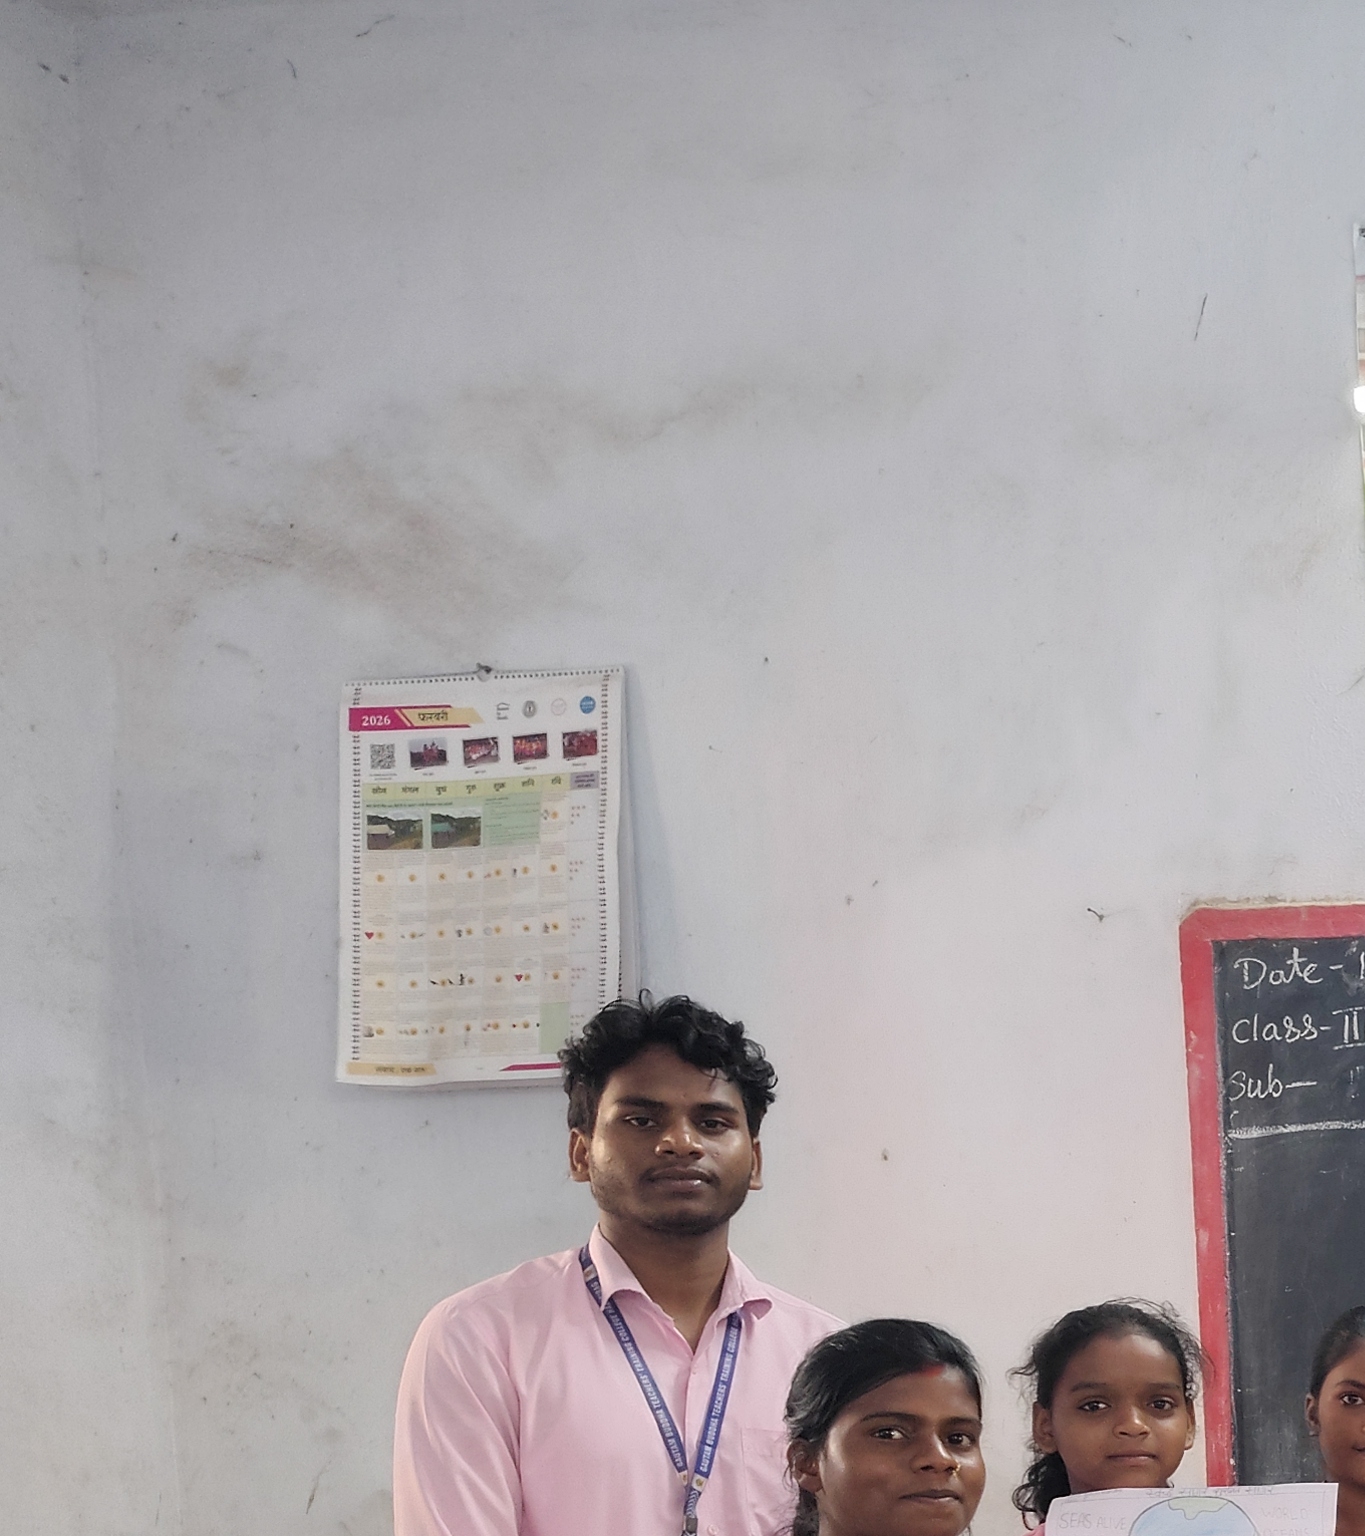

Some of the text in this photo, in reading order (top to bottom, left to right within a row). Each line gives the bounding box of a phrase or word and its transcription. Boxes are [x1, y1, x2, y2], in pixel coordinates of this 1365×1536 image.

[361, 716, 391, 727] 2026
[1059, 1512, 1128, 1530] SEAS ALIVE
[1261, 1507, 1309, 1521] WORLD
